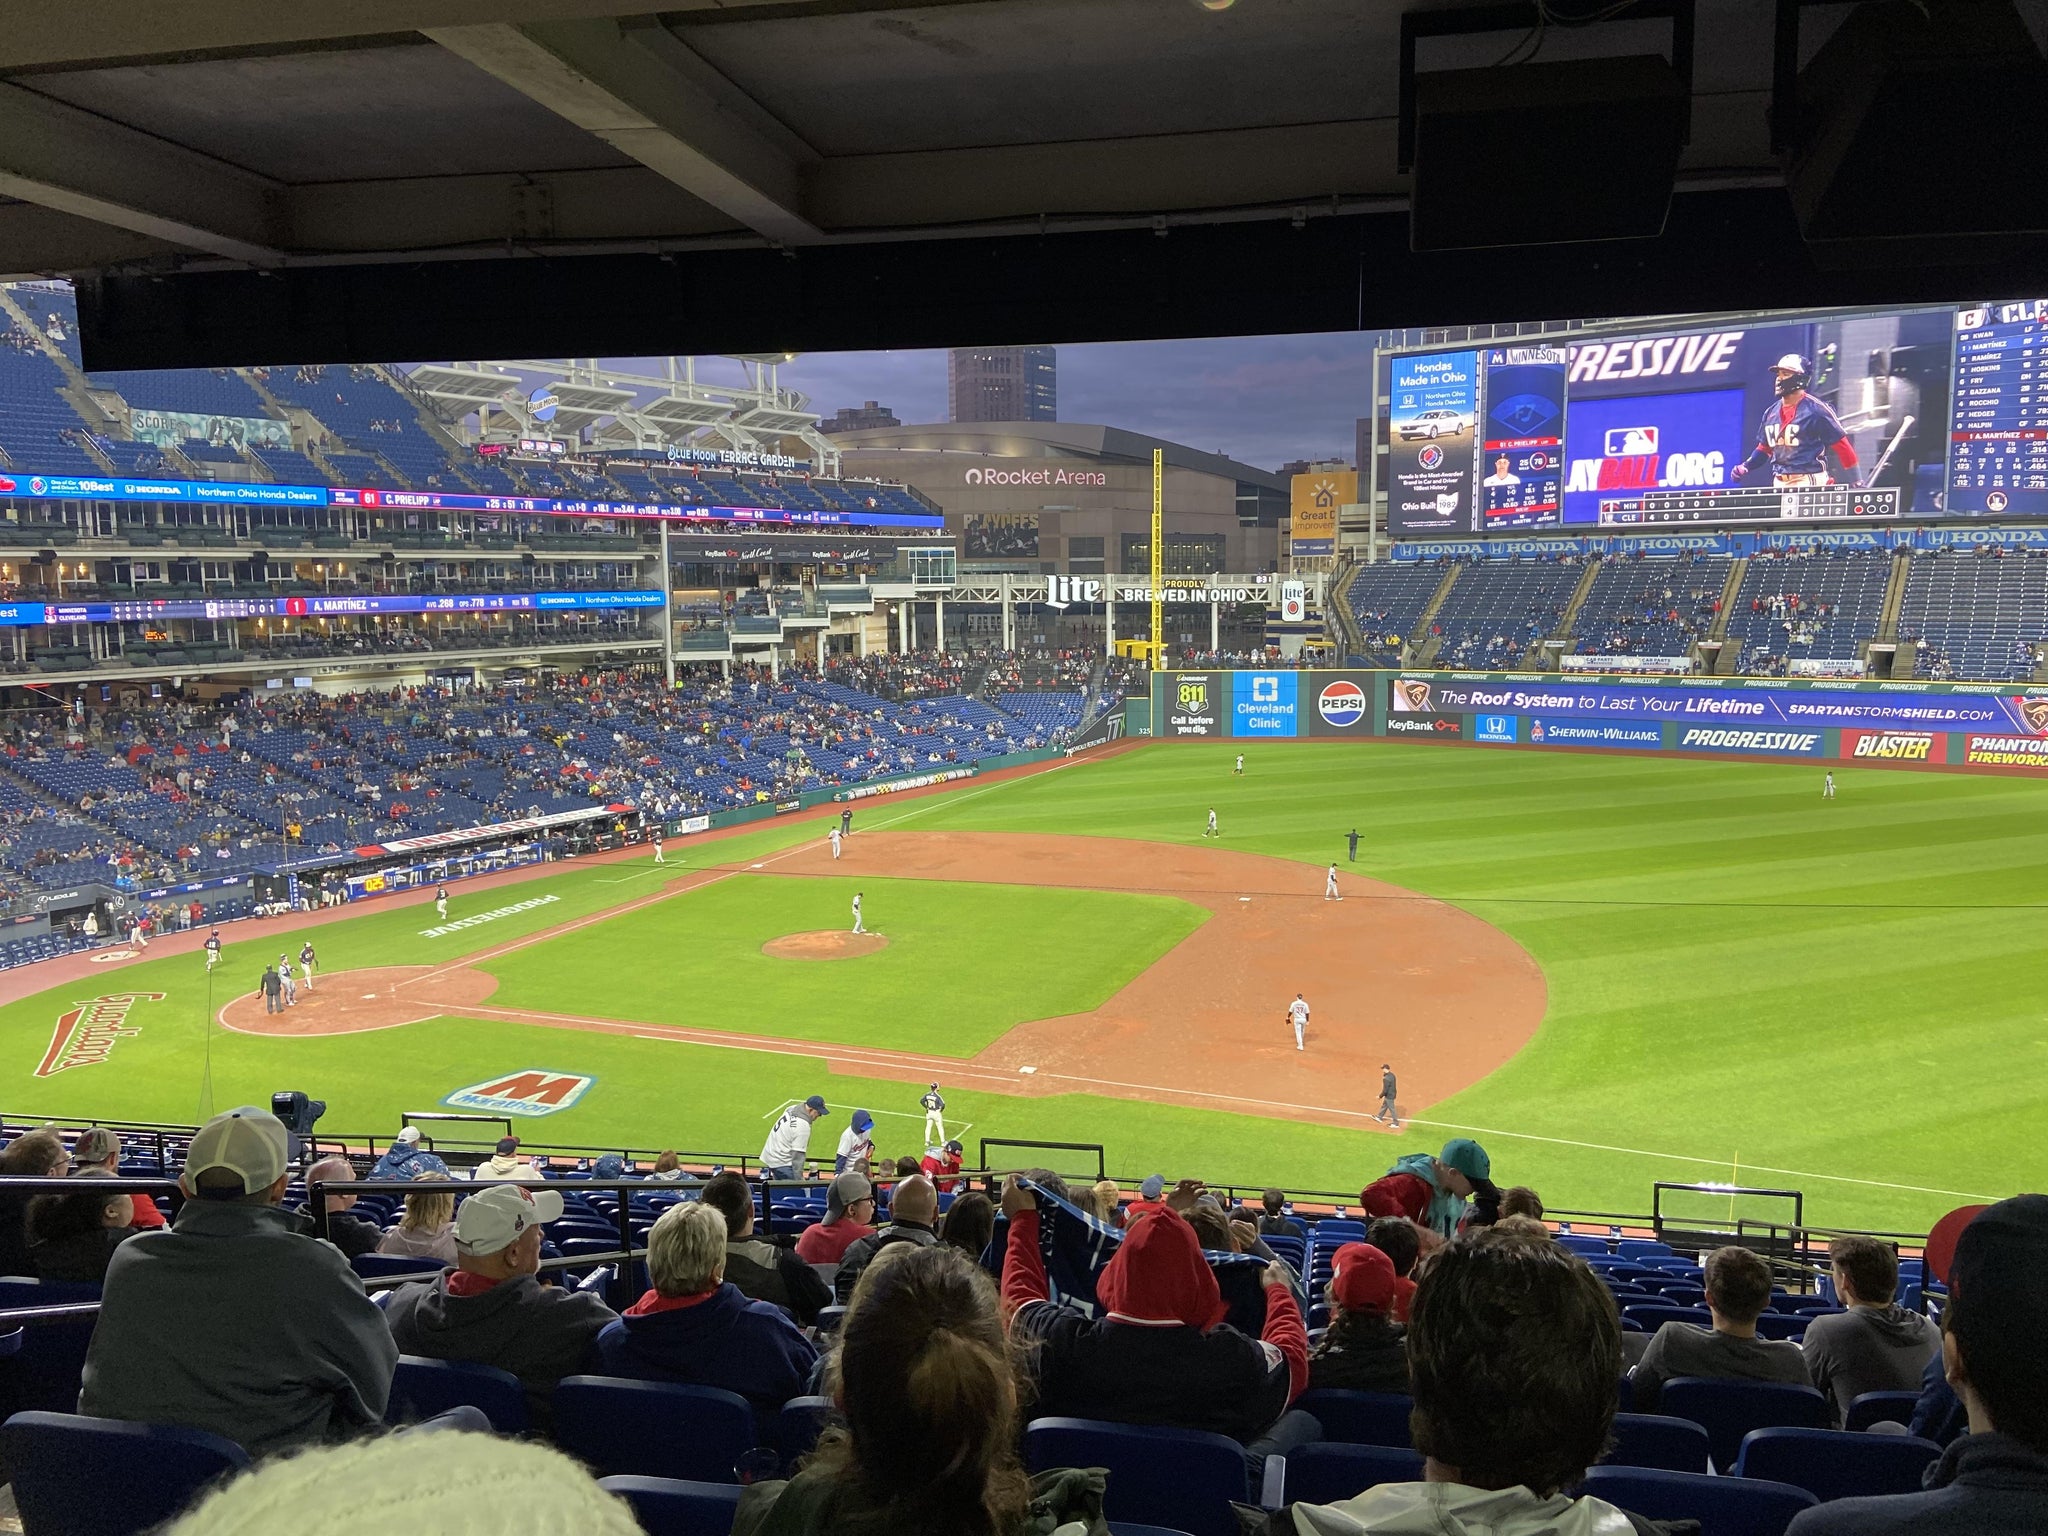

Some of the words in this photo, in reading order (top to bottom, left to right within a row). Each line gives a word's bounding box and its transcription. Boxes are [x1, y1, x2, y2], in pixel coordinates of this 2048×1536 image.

[1965, 313, 1974, 326] C
[1973, 331, 1993, 339] KWAN
[1972, 341, 2007, 350] MARTÍNEZ
[1512, 349, 1560, 364] MINNESOTA
[1569, 332, 1744, 383] RESSIVE
[1971, 352, 2002, 361] RAMÍREZ
[1414, 361, 1453, 373] Hondas
[1400, 376, 1428, 387] Made
[1430, 374, 1439, 384] in
[1441, 372, 1467, 383] Ohio
[543, 397, 558, 408] MOON
[136, 415, 176, 430] SCORE
[1765, 424, 1799, 447] CLE
[1983, 431, 2020, 439] MARTÍNEZ
[668, 444, 691, 460] BLUE
[693, 448, 716, 461] MOON
[720, 450, 758, 465] TERRACE
[760, 453, 795, 467] GARDEN
[984, 468, 1050, 485] Rocket
[1055, 468, 1106, 485] Arena
[78, 480, 114, 492] 10Best
[136, 485, 181, 494] HONDA
[197, 488, 235, 496] Northern
[237, 489, 258, 498] Ohio
[259, 490, 286, 499] Honda
[287, 491, 317, 500] Dealers
[364, 493, 375, 504] 61
[386, 494, 394, 504] C.
[395, 495, 429, 505] PRIELIPP
[490, 498, 500, 509] 25
[507, 498, 515, 509] 51
[576, 503, 586, 512] 1-0
[621, 505, 634, 513] 3.44
[1401, 502, 1419, 510] Ohio
[1420, 501, 1436, 510] Built
[1439, 501, 1456, 509] 1982
[1300, 511, 1327, 520] Great
[1788, 534, 1877, 545] HONDA
[1951, 530, 2047, 543] HONDA
[1507, 541, 1579, 552] HONDA
[1640, 538, 1720, 549] HONDA
[1416, 543, 1484, 556] HONDA
[1165, 580, 1206, 588] PROUDLY
[1045, 574, 1101, 609] Lite
[1124, 589, 1188, 602] BREWED
[1190, 589, 1206, 602] IN
[1210, 589, 1247, 602] OHIO
[1285, 587, 1303, 599] Lite
[314, 601, 323, 611] A.
[324, 598, 367, 611] MARTÍNEZ
[470, 599, 484, 607] .778
[520, 597, 528, 606] 16
[585, 596, 609, 604] Northern
[624, 595, 641, 603] Honda
[642, 595, 660, 603] Dealers
[1680, 678, 1724, 686] PROGRESSIVE
[1744, 680, 1790, 688] PROGRESSIVE
[1811, 681, 1857, 689] PROGRESSIVE
[1880, 683, 1929, 691] PROGRESSIVE
[1180, 685, 1204, 703] 811
[1952, 685, 2002, 693] PROGRESSIVE
[1322, 699, 1363, 709] PEPSI
[1440, 690, 1467, 704] The
[1470, 691, 1513, 706] Roof
[1513, 692, 1574, 709] System
[1578, 695, 1596, 709] to
[1600, 696, 1636, 710] Last
[1641, 696, 1683, 711] Your
[1685, 698, 1765, 715] Lifetime
[1237, 703, 1294, 714] Cleveland
[1789, 703, 1994, 721] SPARTANSTORMSHIELD.COM
[1171, 716, 1186, 724] Call
[1188, 716, 1214, 724] before
[1249, 717, 1281, 728] Clinic
[1388, 719, 1434, 731] KeyBank
[1177, 726, 1192, 734] you
[1193, 725, 1207, 734] dig.
[1682, 729, 1819, 751] PROGRESSIVE
[399, 820, 539, 848] CLEVELAND
[223, 877, 238, 885] meijer
[187, 883, 203, 891] meijer
[49, 891, 78, 901] LEXUS
[150, 889, 167, 898] meijer
[417, 894, 561, 938] PROGRESSIVE
[33, 992, 167, 1078] Guardians
[454, 1094, 552, 1112] Marathon
[773, 1115, 788, 1133] 5
